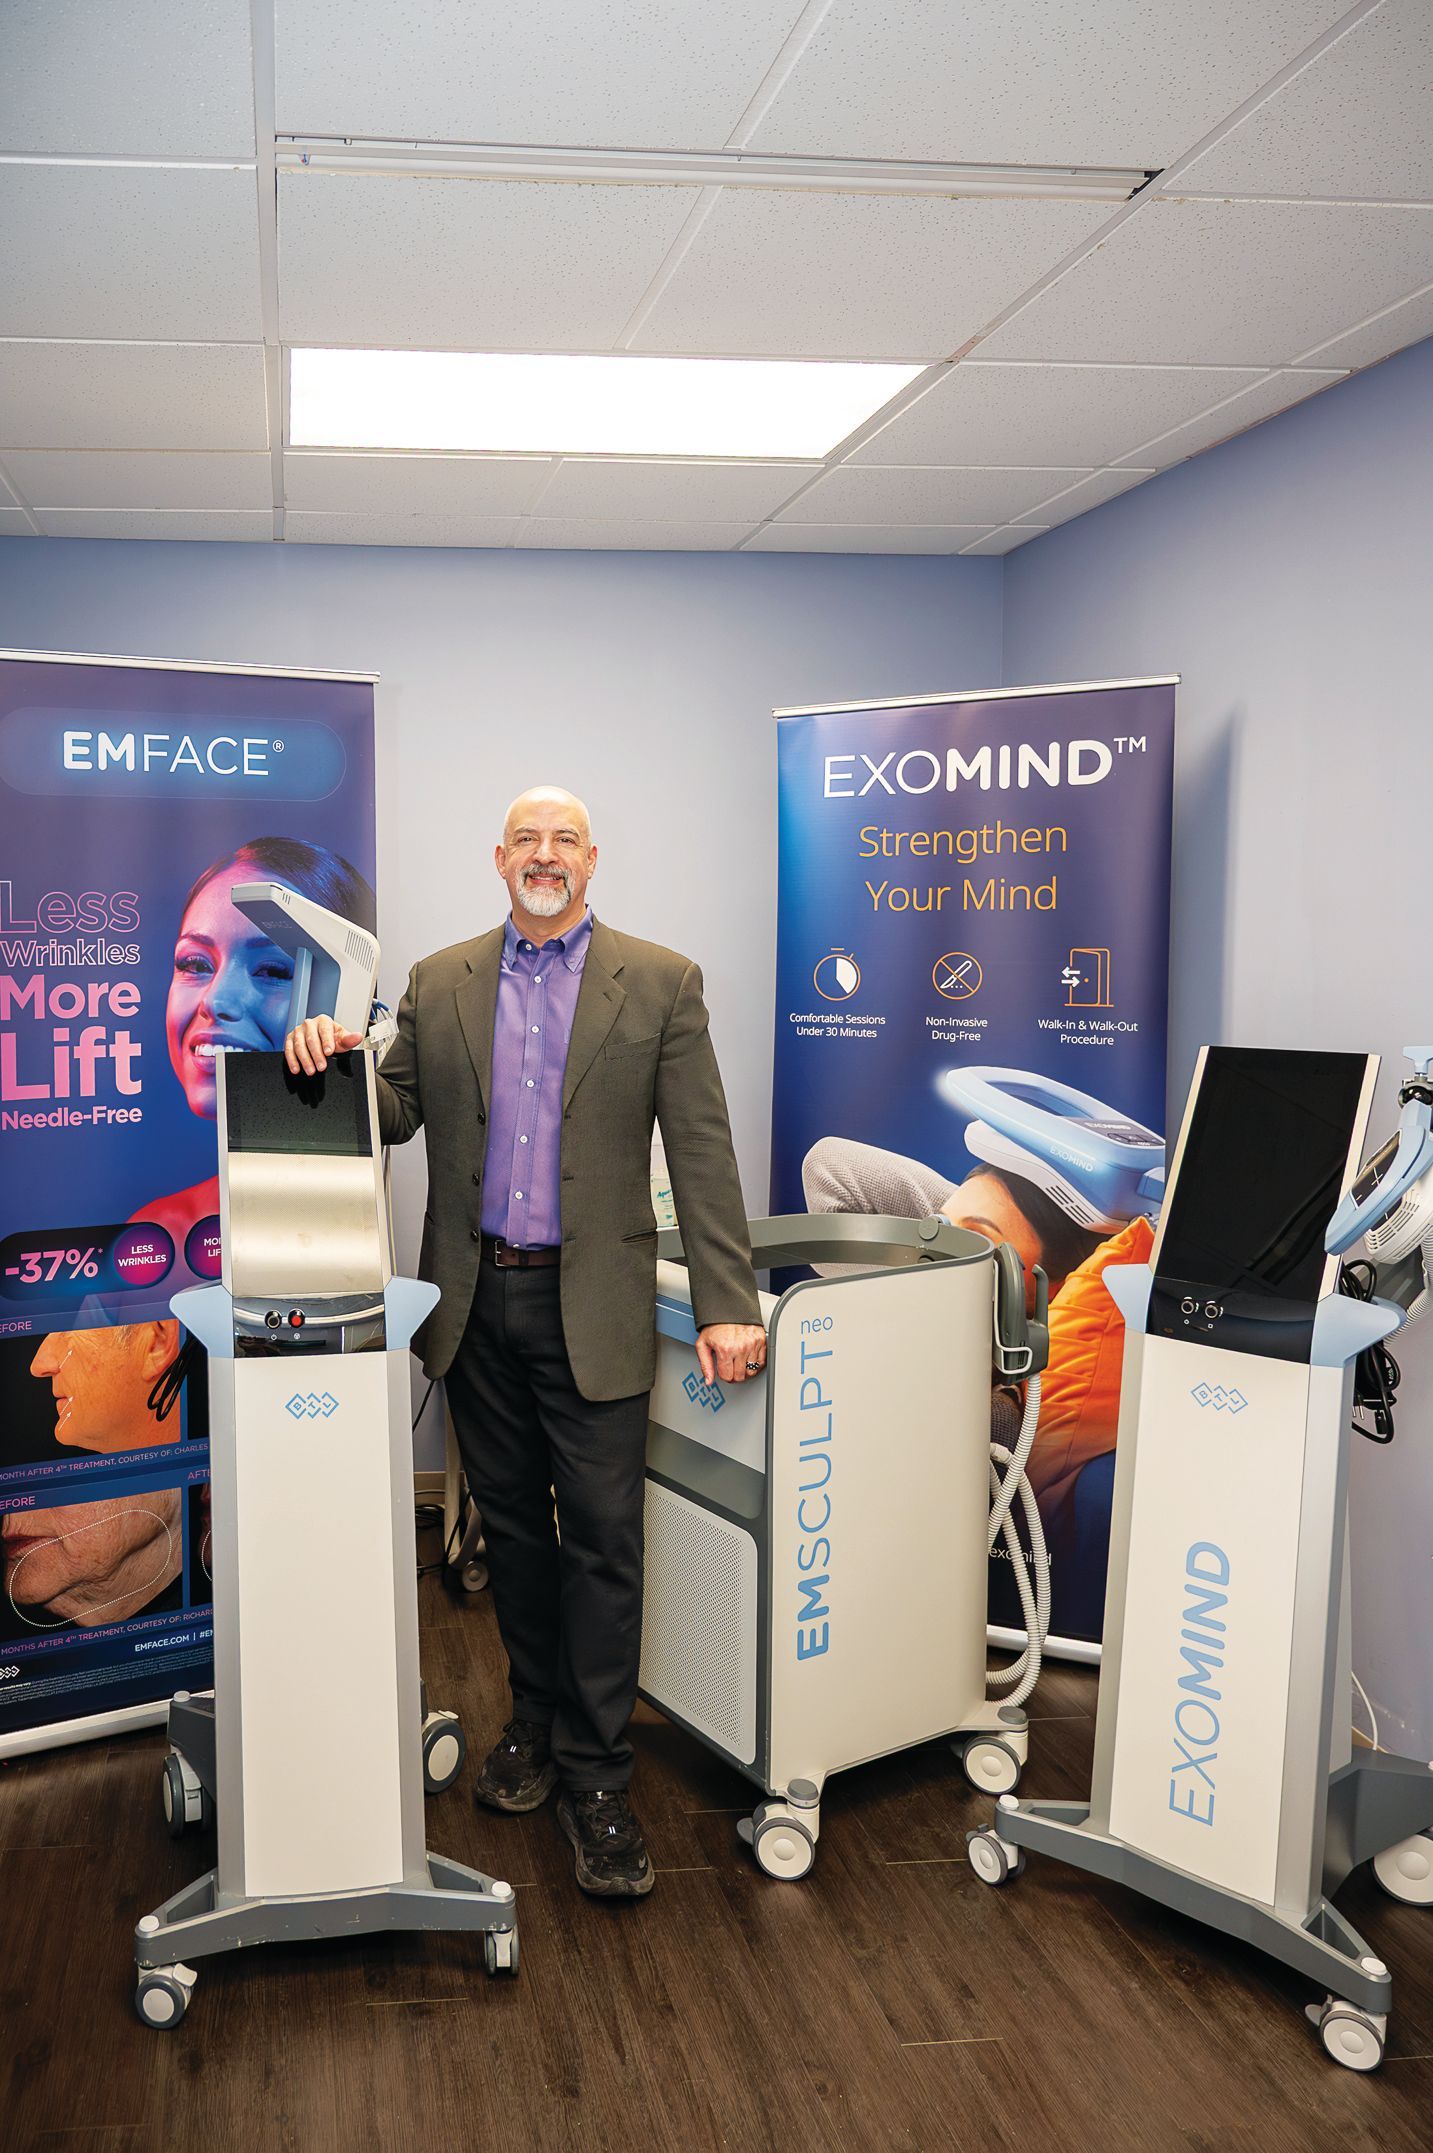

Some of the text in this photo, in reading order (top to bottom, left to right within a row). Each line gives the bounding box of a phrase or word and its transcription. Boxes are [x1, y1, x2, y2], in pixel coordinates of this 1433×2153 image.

[858, 820, 1068, 864] Strengthen
[865, 875, 1057, 912] Your Mind
[0, 880, 140, 934] Less
[0, 938, 140, 967] Wrinkles
[0, 974, 141, 1021] More
[789, 1013, 886, 1025] Comfortable Sessions
[796, 1026, 878, 1038] Under 30 Minutes
[925, 1016, 988, 1028] Non-Invasive
[1037, 1019, 1139, 1032] Walk-In & Walk-Out
[931, 1030, 981, 1043] Drug-Free
[1060, 1034, 1115, 1046] Procedure
[0, 1026, 142, 1101] Lift
[1, 1105, 143, 1131] Needle-Free
[1049, 1145, 1094, 1172] EXOMIND
[117, 1254, 167, 1267] WRINKLES
[131, 1244, 154, 1255] LESS
[800, 1316, 834, 1335] neo
[27, 1466, 54, 1477] AFTER
[118, 1451, 159, 1464] COURTESY
[174, 1443, 209, 1455] CHARLES
[797, 1341, 833, 1661] EMSCULPT
[1, 1642, 36, 1656] MONTHS
[37, 1638, 64, 1649] AFTER
[127, 1618, 167, 1632] COURTESY
[134, 1634, 190, 1652] EMFACE.COM
[1169, 1541, 1231, 1827] EXOMIND
